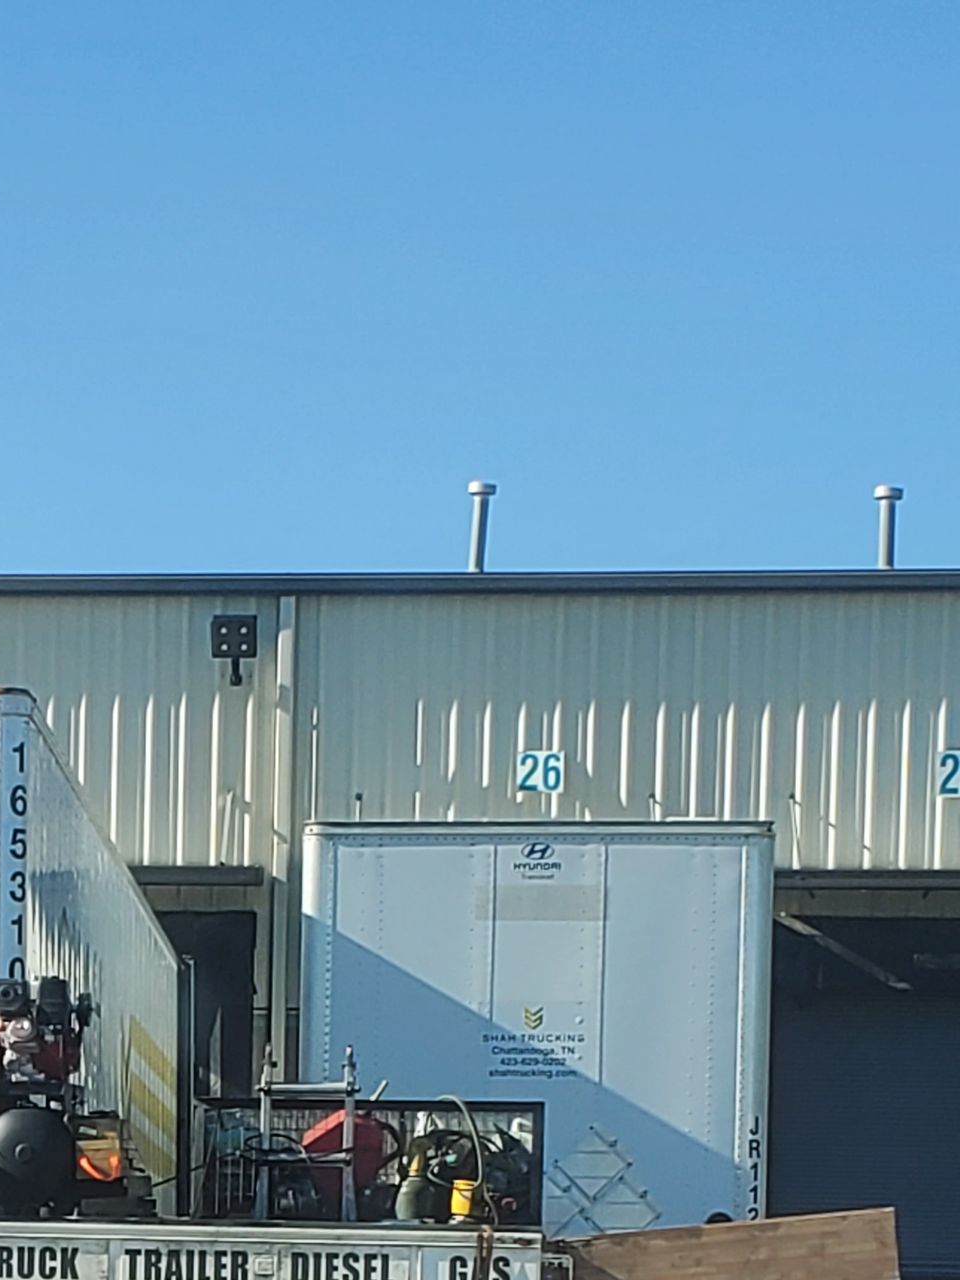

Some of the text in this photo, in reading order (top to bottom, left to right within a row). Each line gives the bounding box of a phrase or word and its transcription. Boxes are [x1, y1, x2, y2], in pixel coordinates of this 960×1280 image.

[519, 754, 561, 792] 26
[940, 753, 959, 794] 2
[513, 862, 561, 870] HYUNDAI
[482, 1034, 585, 1043] SHAH TRUCKING
[561, 1047, 575, 1055] TN
